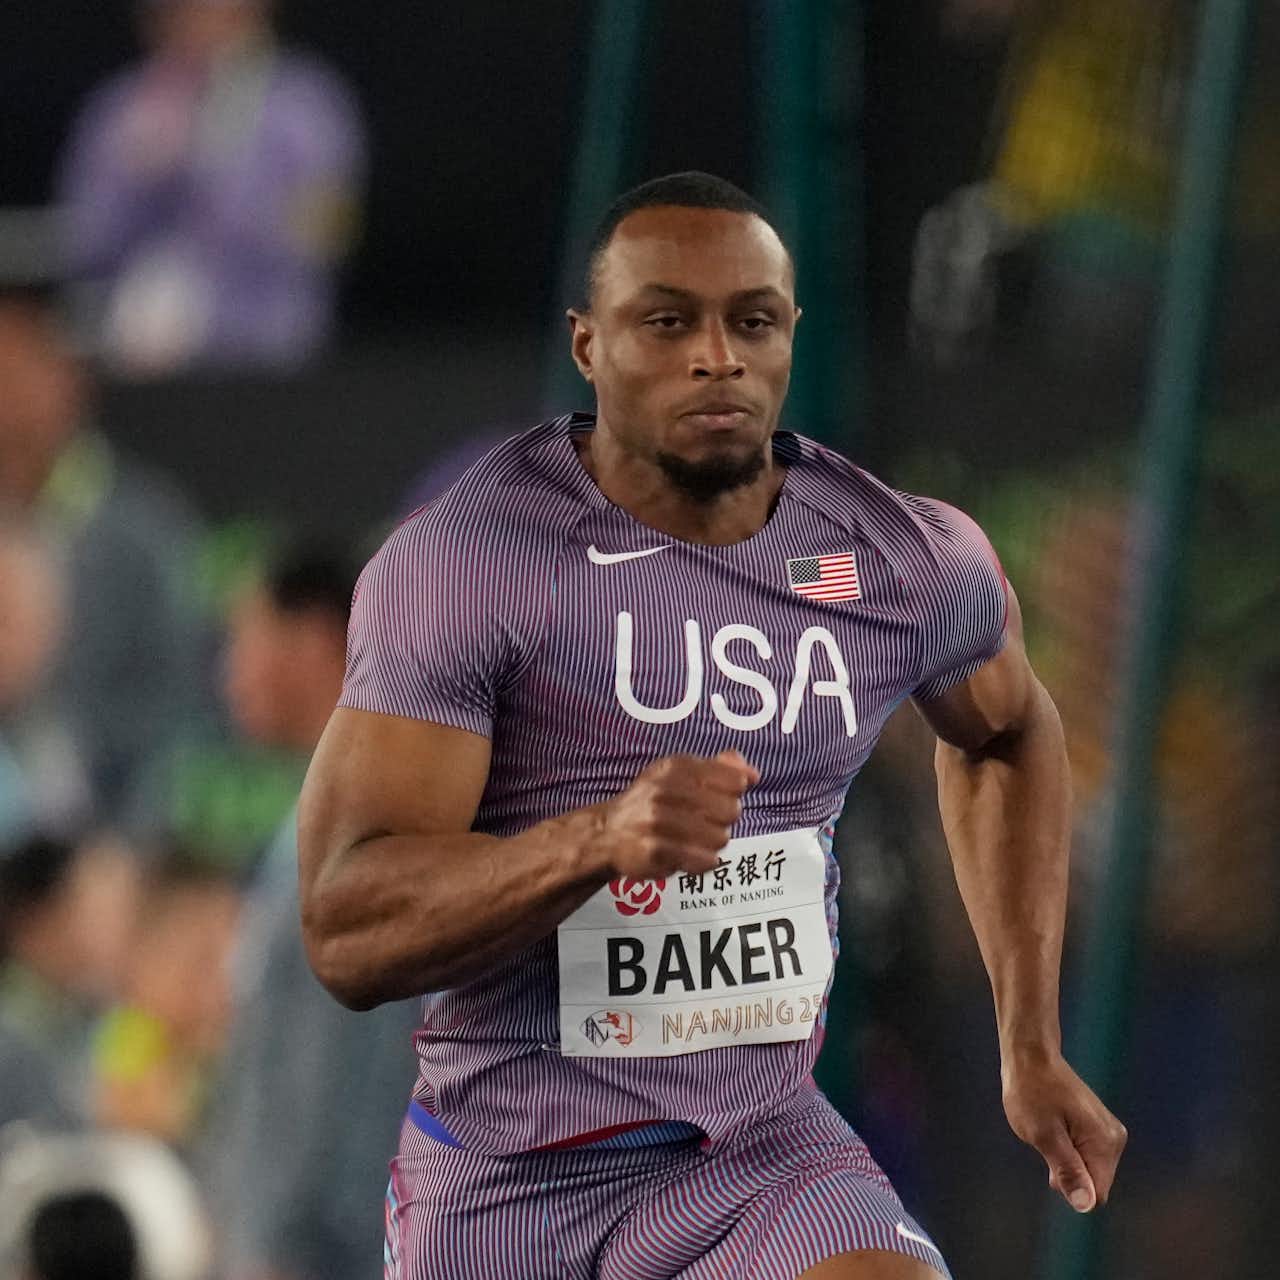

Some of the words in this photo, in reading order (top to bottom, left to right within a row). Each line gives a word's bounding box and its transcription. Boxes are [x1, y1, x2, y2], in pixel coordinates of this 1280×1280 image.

[615, 611, 856, 737] USA
[680, 897, 717, 910] BANK
[722, 895, 734, 905] OF
[740, 886, 784, 904] NANJING
[607, 918, 803, 996] BAKER
[661, 997, 793, 1044] NANJING
